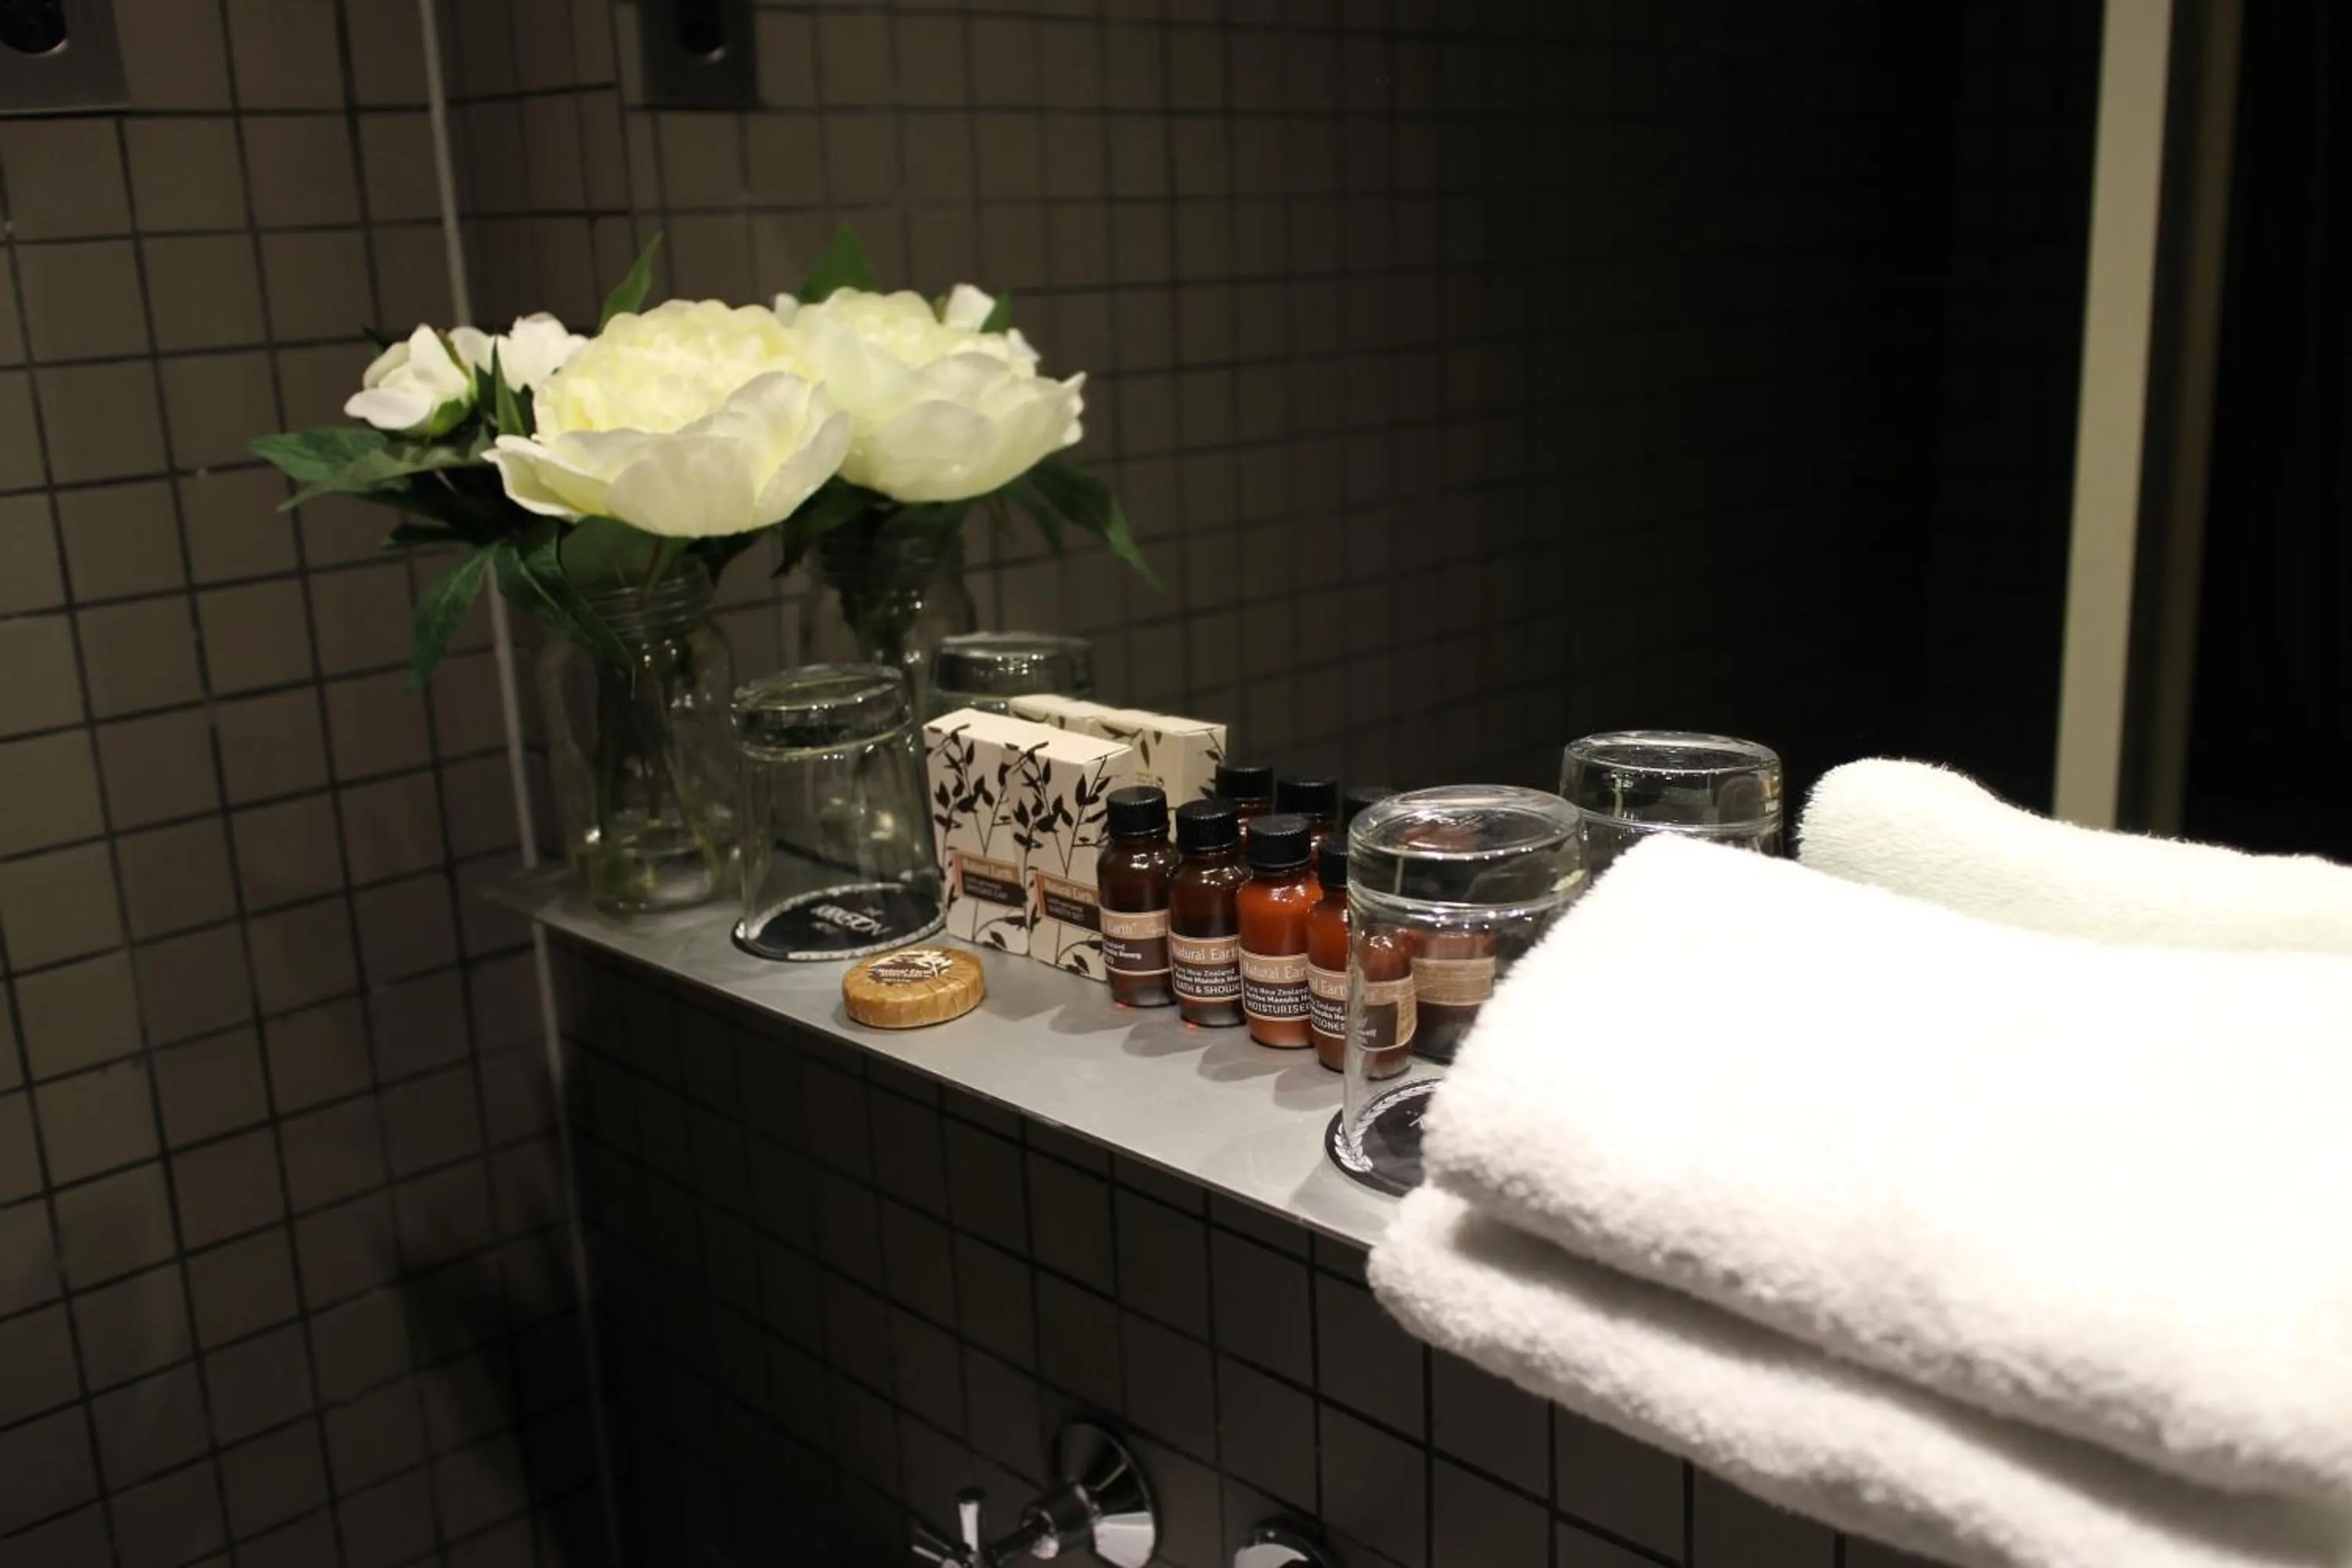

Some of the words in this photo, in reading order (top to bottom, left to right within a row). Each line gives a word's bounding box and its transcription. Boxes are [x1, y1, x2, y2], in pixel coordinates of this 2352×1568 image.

[1187, 967, 1202, 976] New
[1204, 967, 1235, 977] Zealand
[1285, 965, 1307, 979] Ear
[1194, 975, 1225, 984] Manuka
[1196, 985, 1203, 993] &
[1259, 988, 1276, 996] New
[1267, 995, 1299, 1004] Manuka
